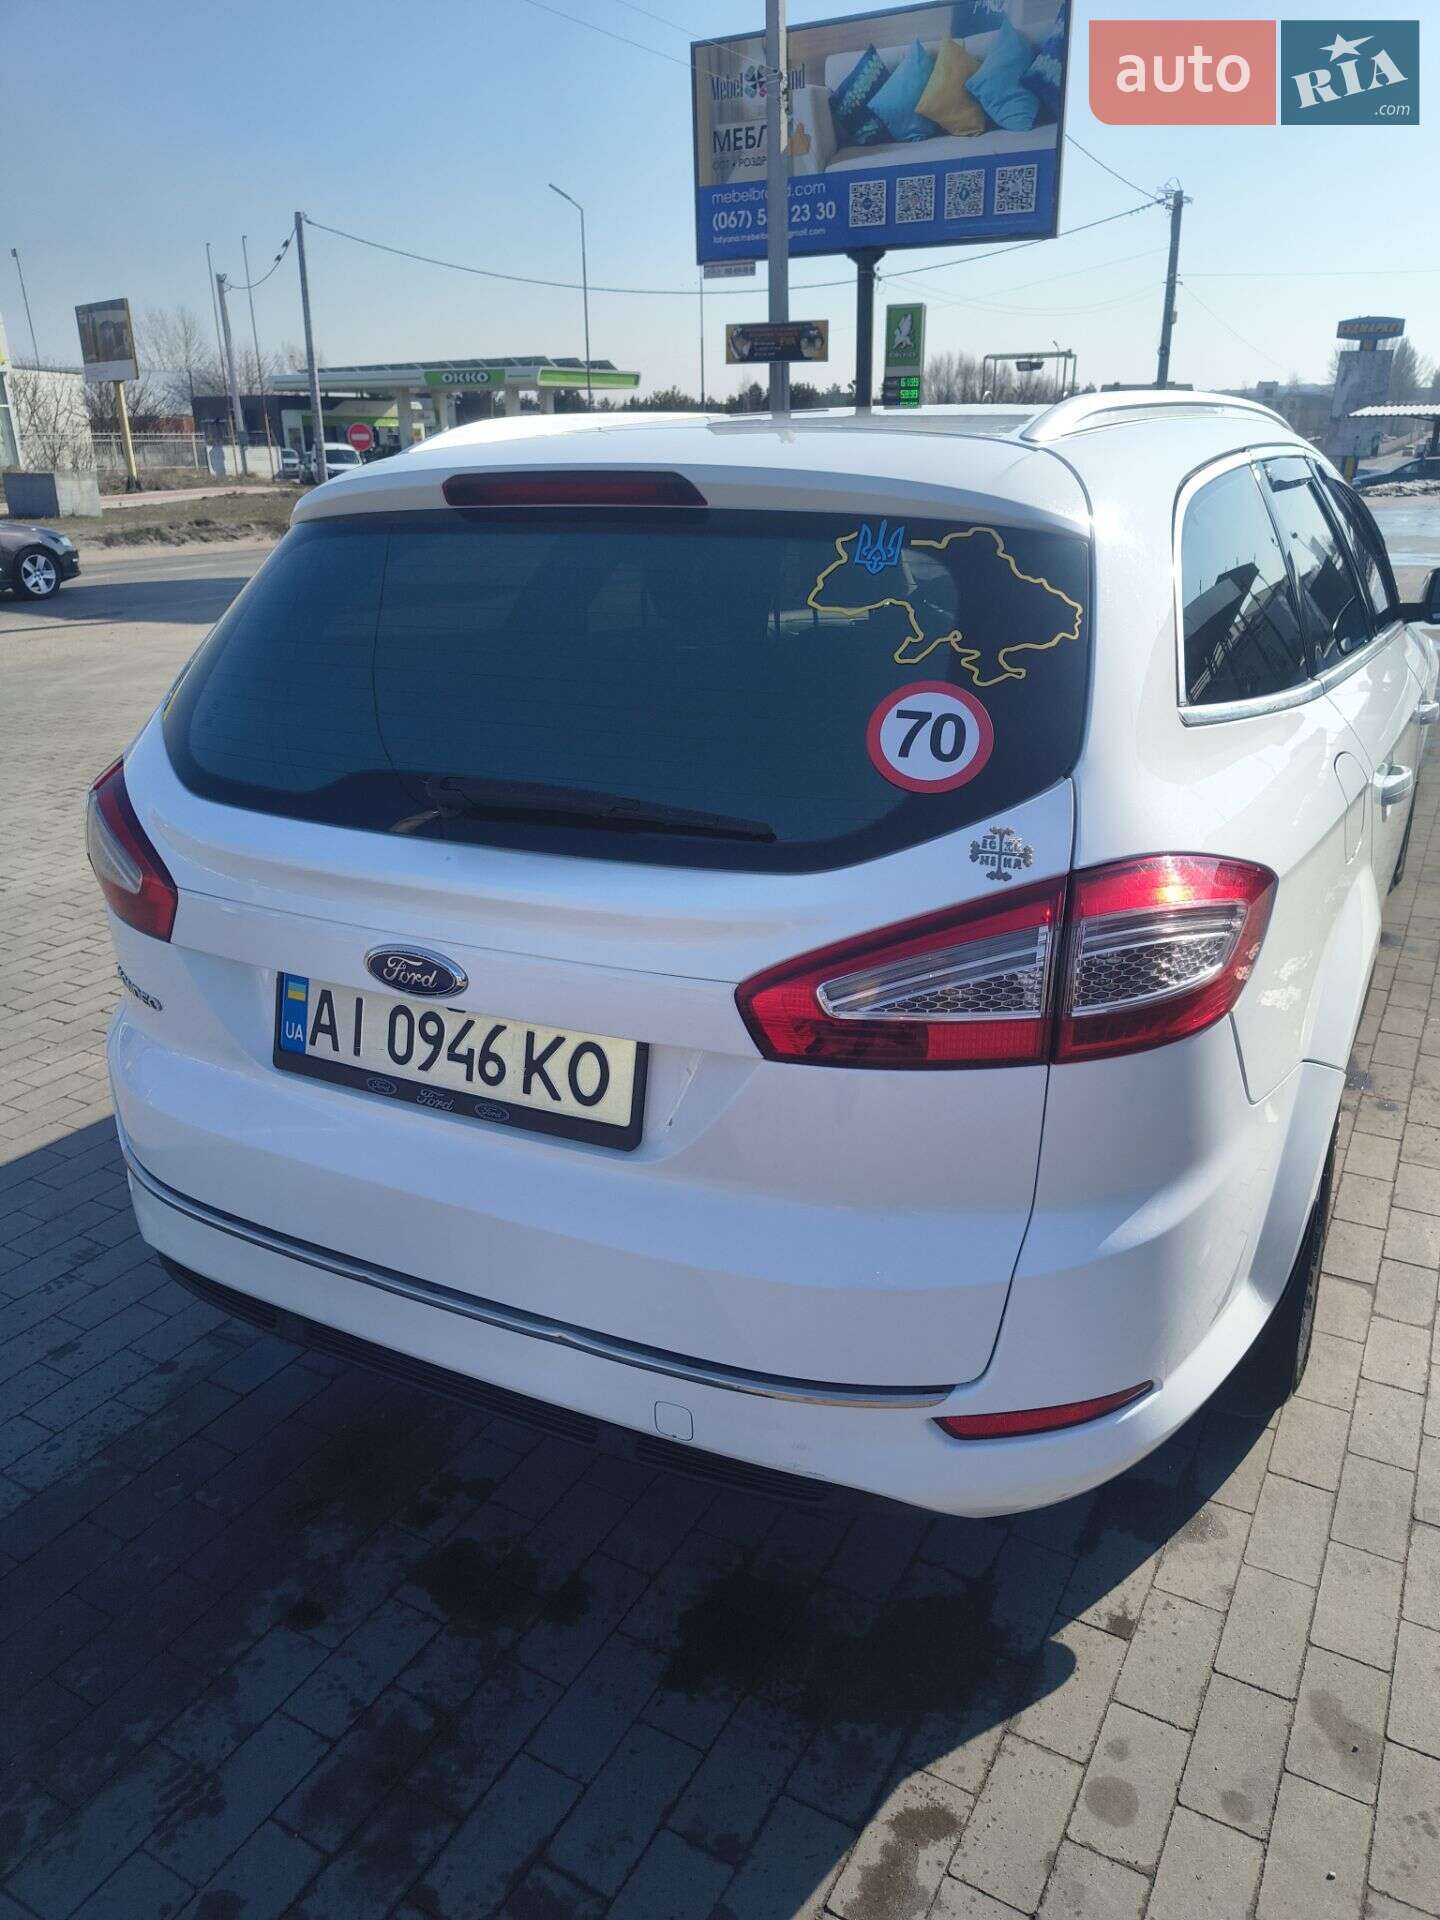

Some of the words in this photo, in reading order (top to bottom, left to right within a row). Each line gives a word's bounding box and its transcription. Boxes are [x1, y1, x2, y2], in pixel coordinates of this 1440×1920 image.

[711, 72, 743, 100] Mebel
[712, 124, 768, 153] МЕБЛ
[711, 182, 826, 204] mebelbrd.com
[712, 210, 752, 231] (067)
[791, 204, 811, 222] 23
[815, 201, 836, 220] 30
[895, 709, 967, 763] 70
[383, 954, 439, 990] Ford
[285, 1020, 304, 1043] UA
[386, 1003, 507, 1087] 0946
[522, 1030, 610, 1107] KO
[416, 1088, 455, 1112] Ford
